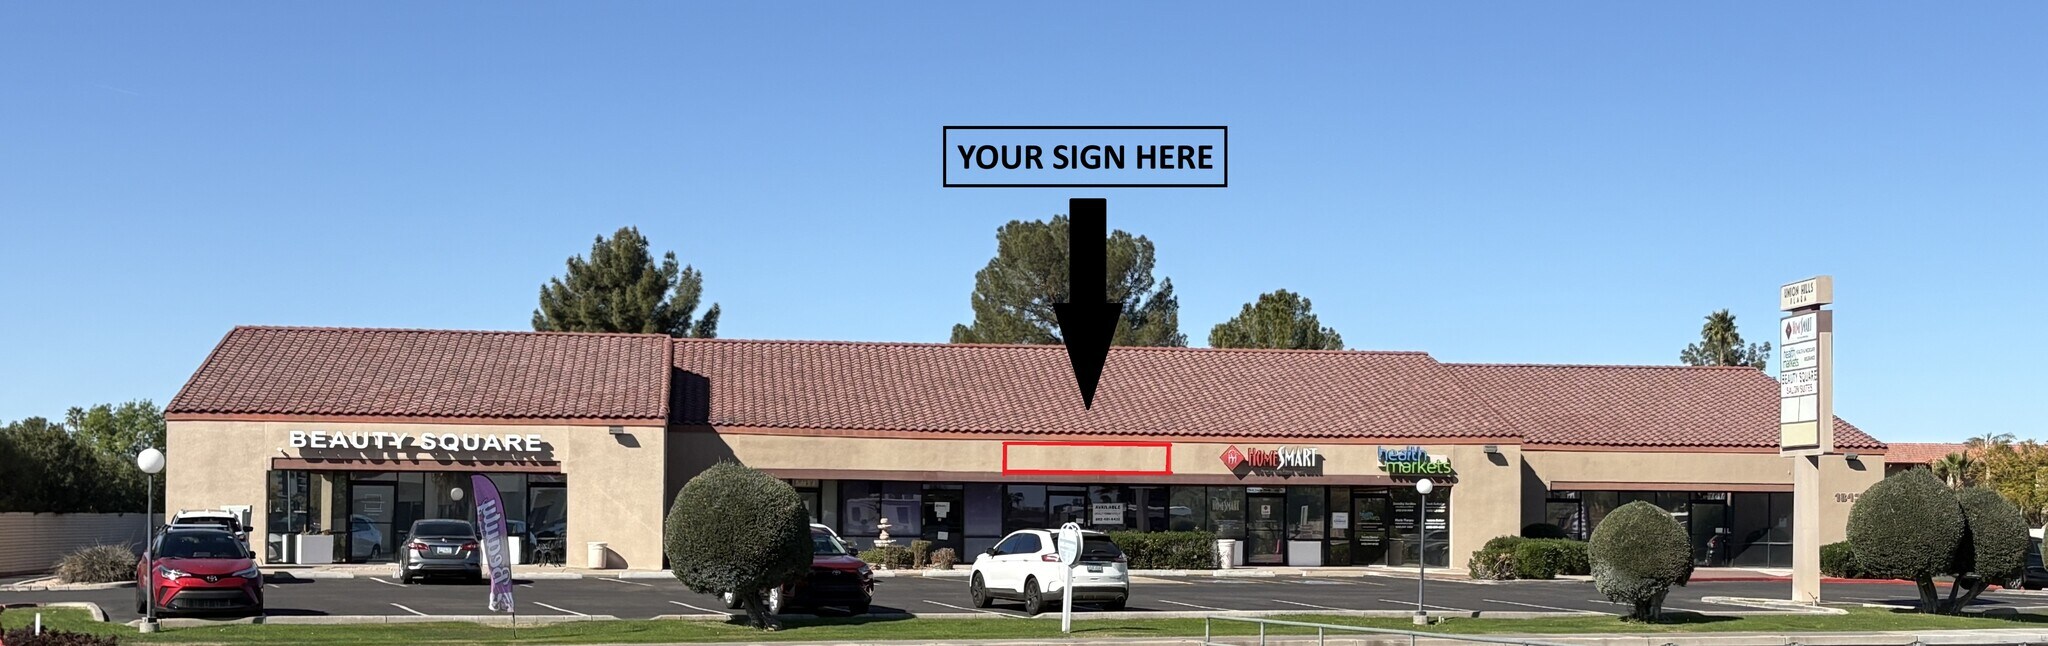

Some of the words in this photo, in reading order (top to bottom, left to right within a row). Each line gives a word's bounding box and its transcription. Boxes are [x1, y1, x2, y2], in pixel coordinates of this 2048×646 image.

[1784, 285, 1799, 298] UNION
[1801, 282, 1814, 295] HILLS
[1781, 373, 1798, 385] BEAUTY
[1799, 370, 1817, 383] SQUARE
[289, 430, 408, 449] BEAUTY
[420, 433, 541, 451] SQUARE
[1378, 446, 1428, 461] health
[1385, 459, 1451, 474] markets
